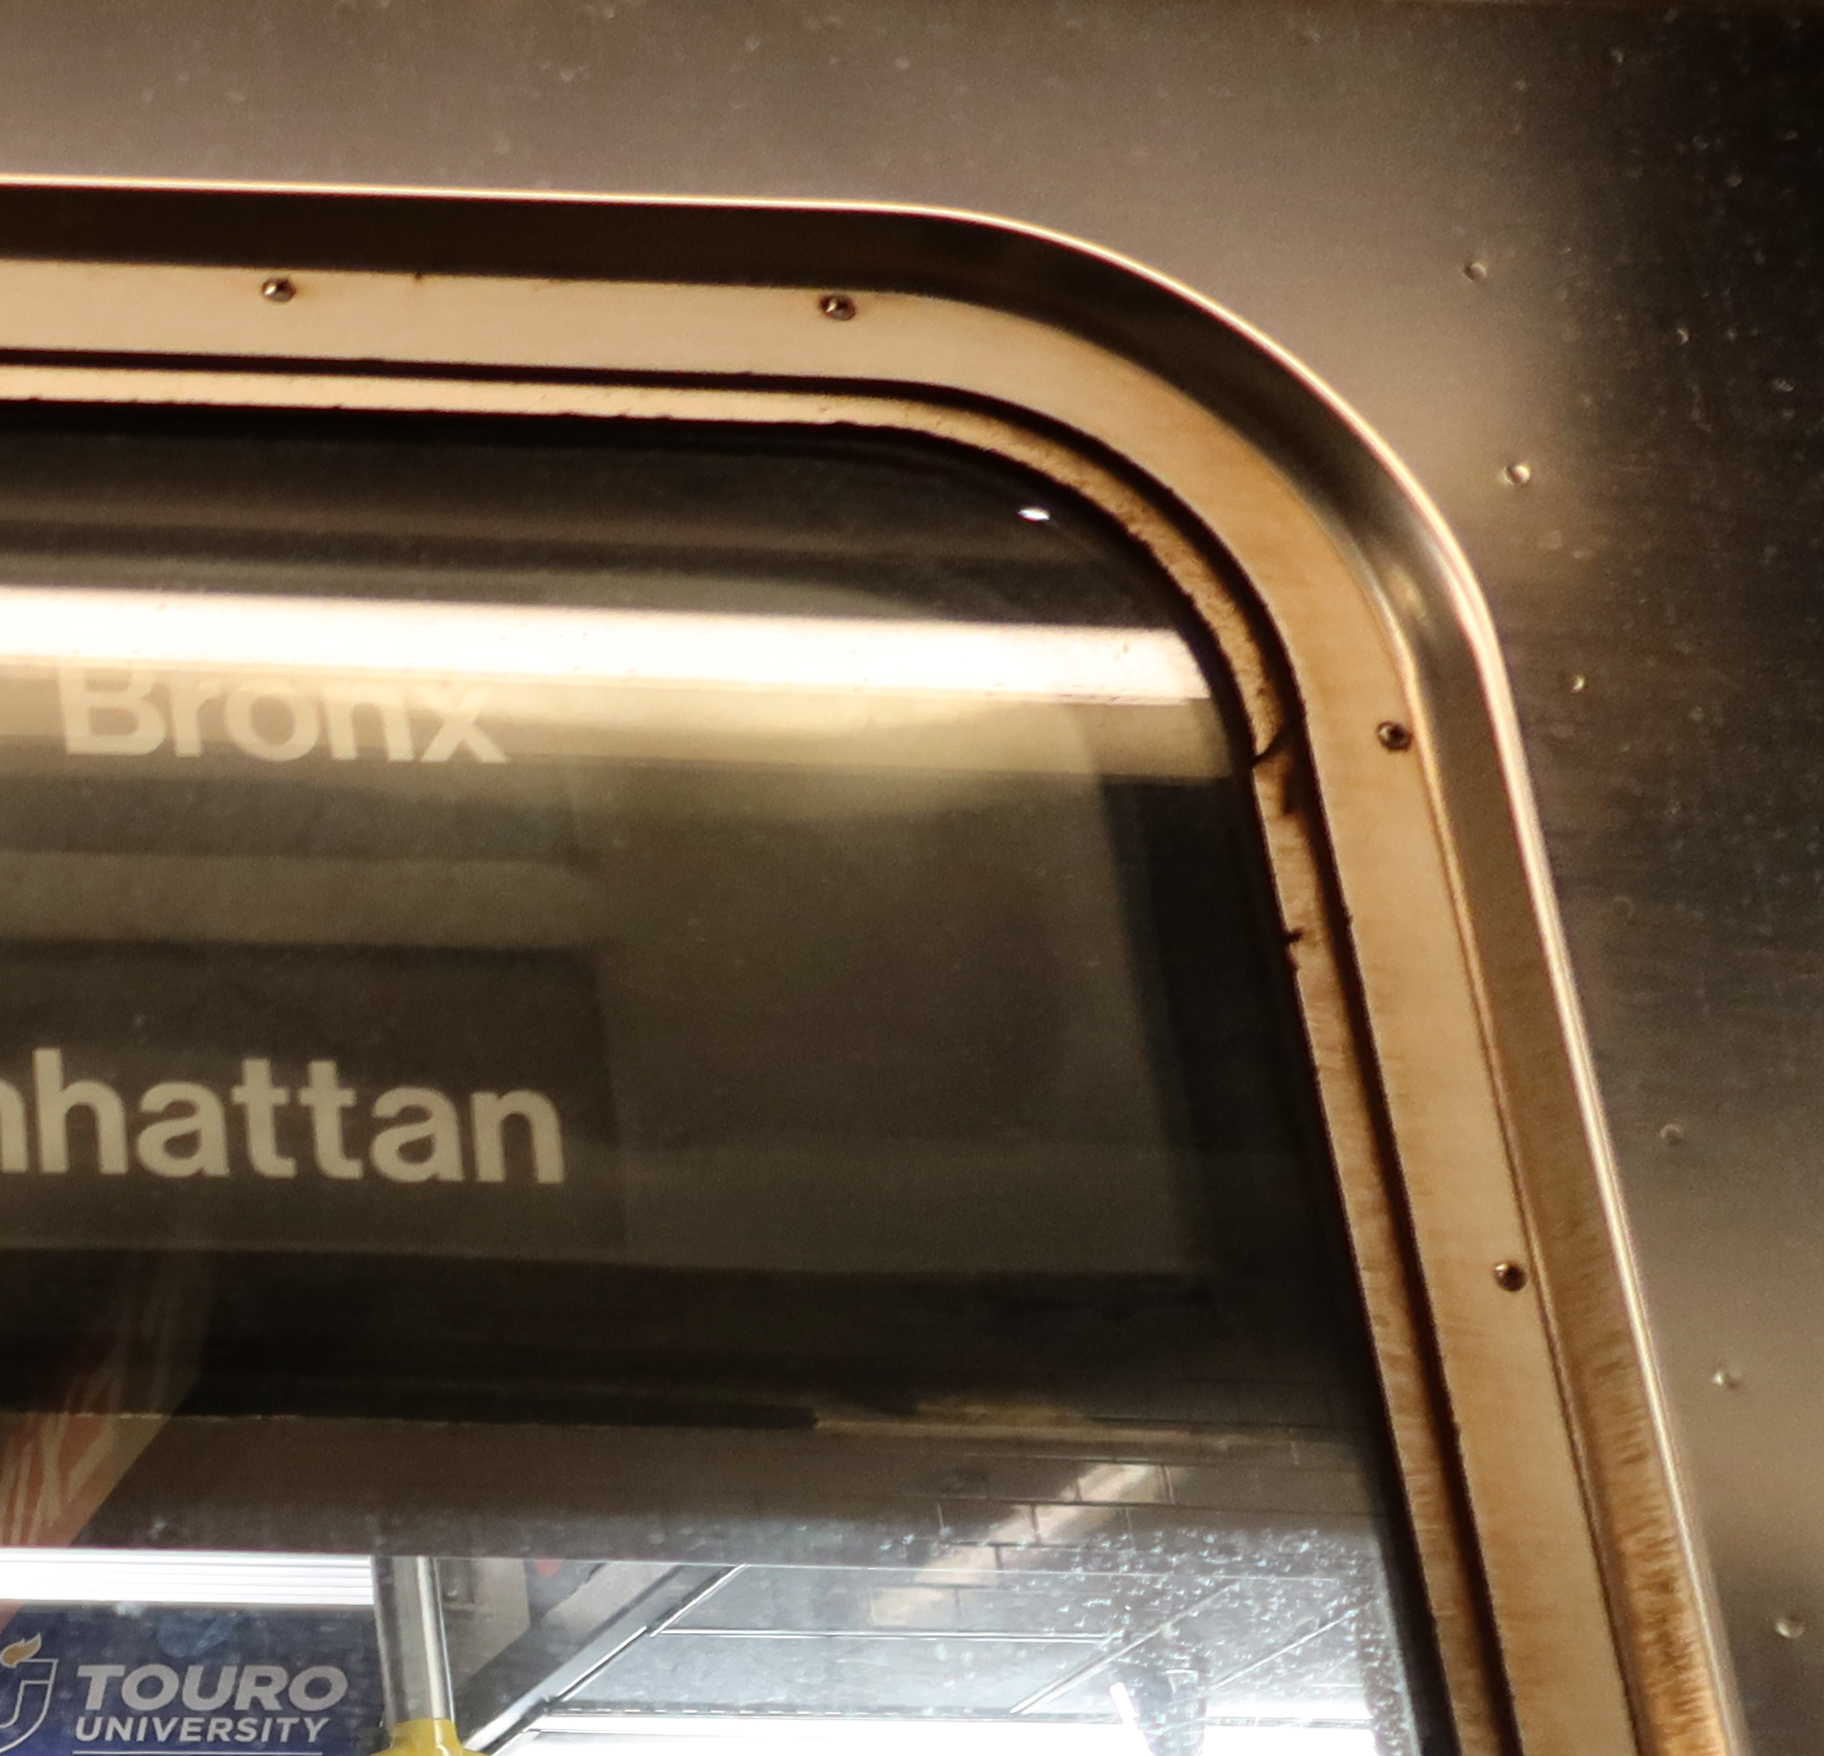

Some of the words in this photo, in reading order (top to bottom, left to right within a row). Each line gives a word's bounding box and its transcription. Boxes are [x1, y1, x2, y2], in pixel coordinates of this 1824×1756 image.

[55, 652, 508, 764] Bronx
[76, 1664, 348, 1711] TOURO
[75, 1716, 330, 1743] UNIVERSITY
